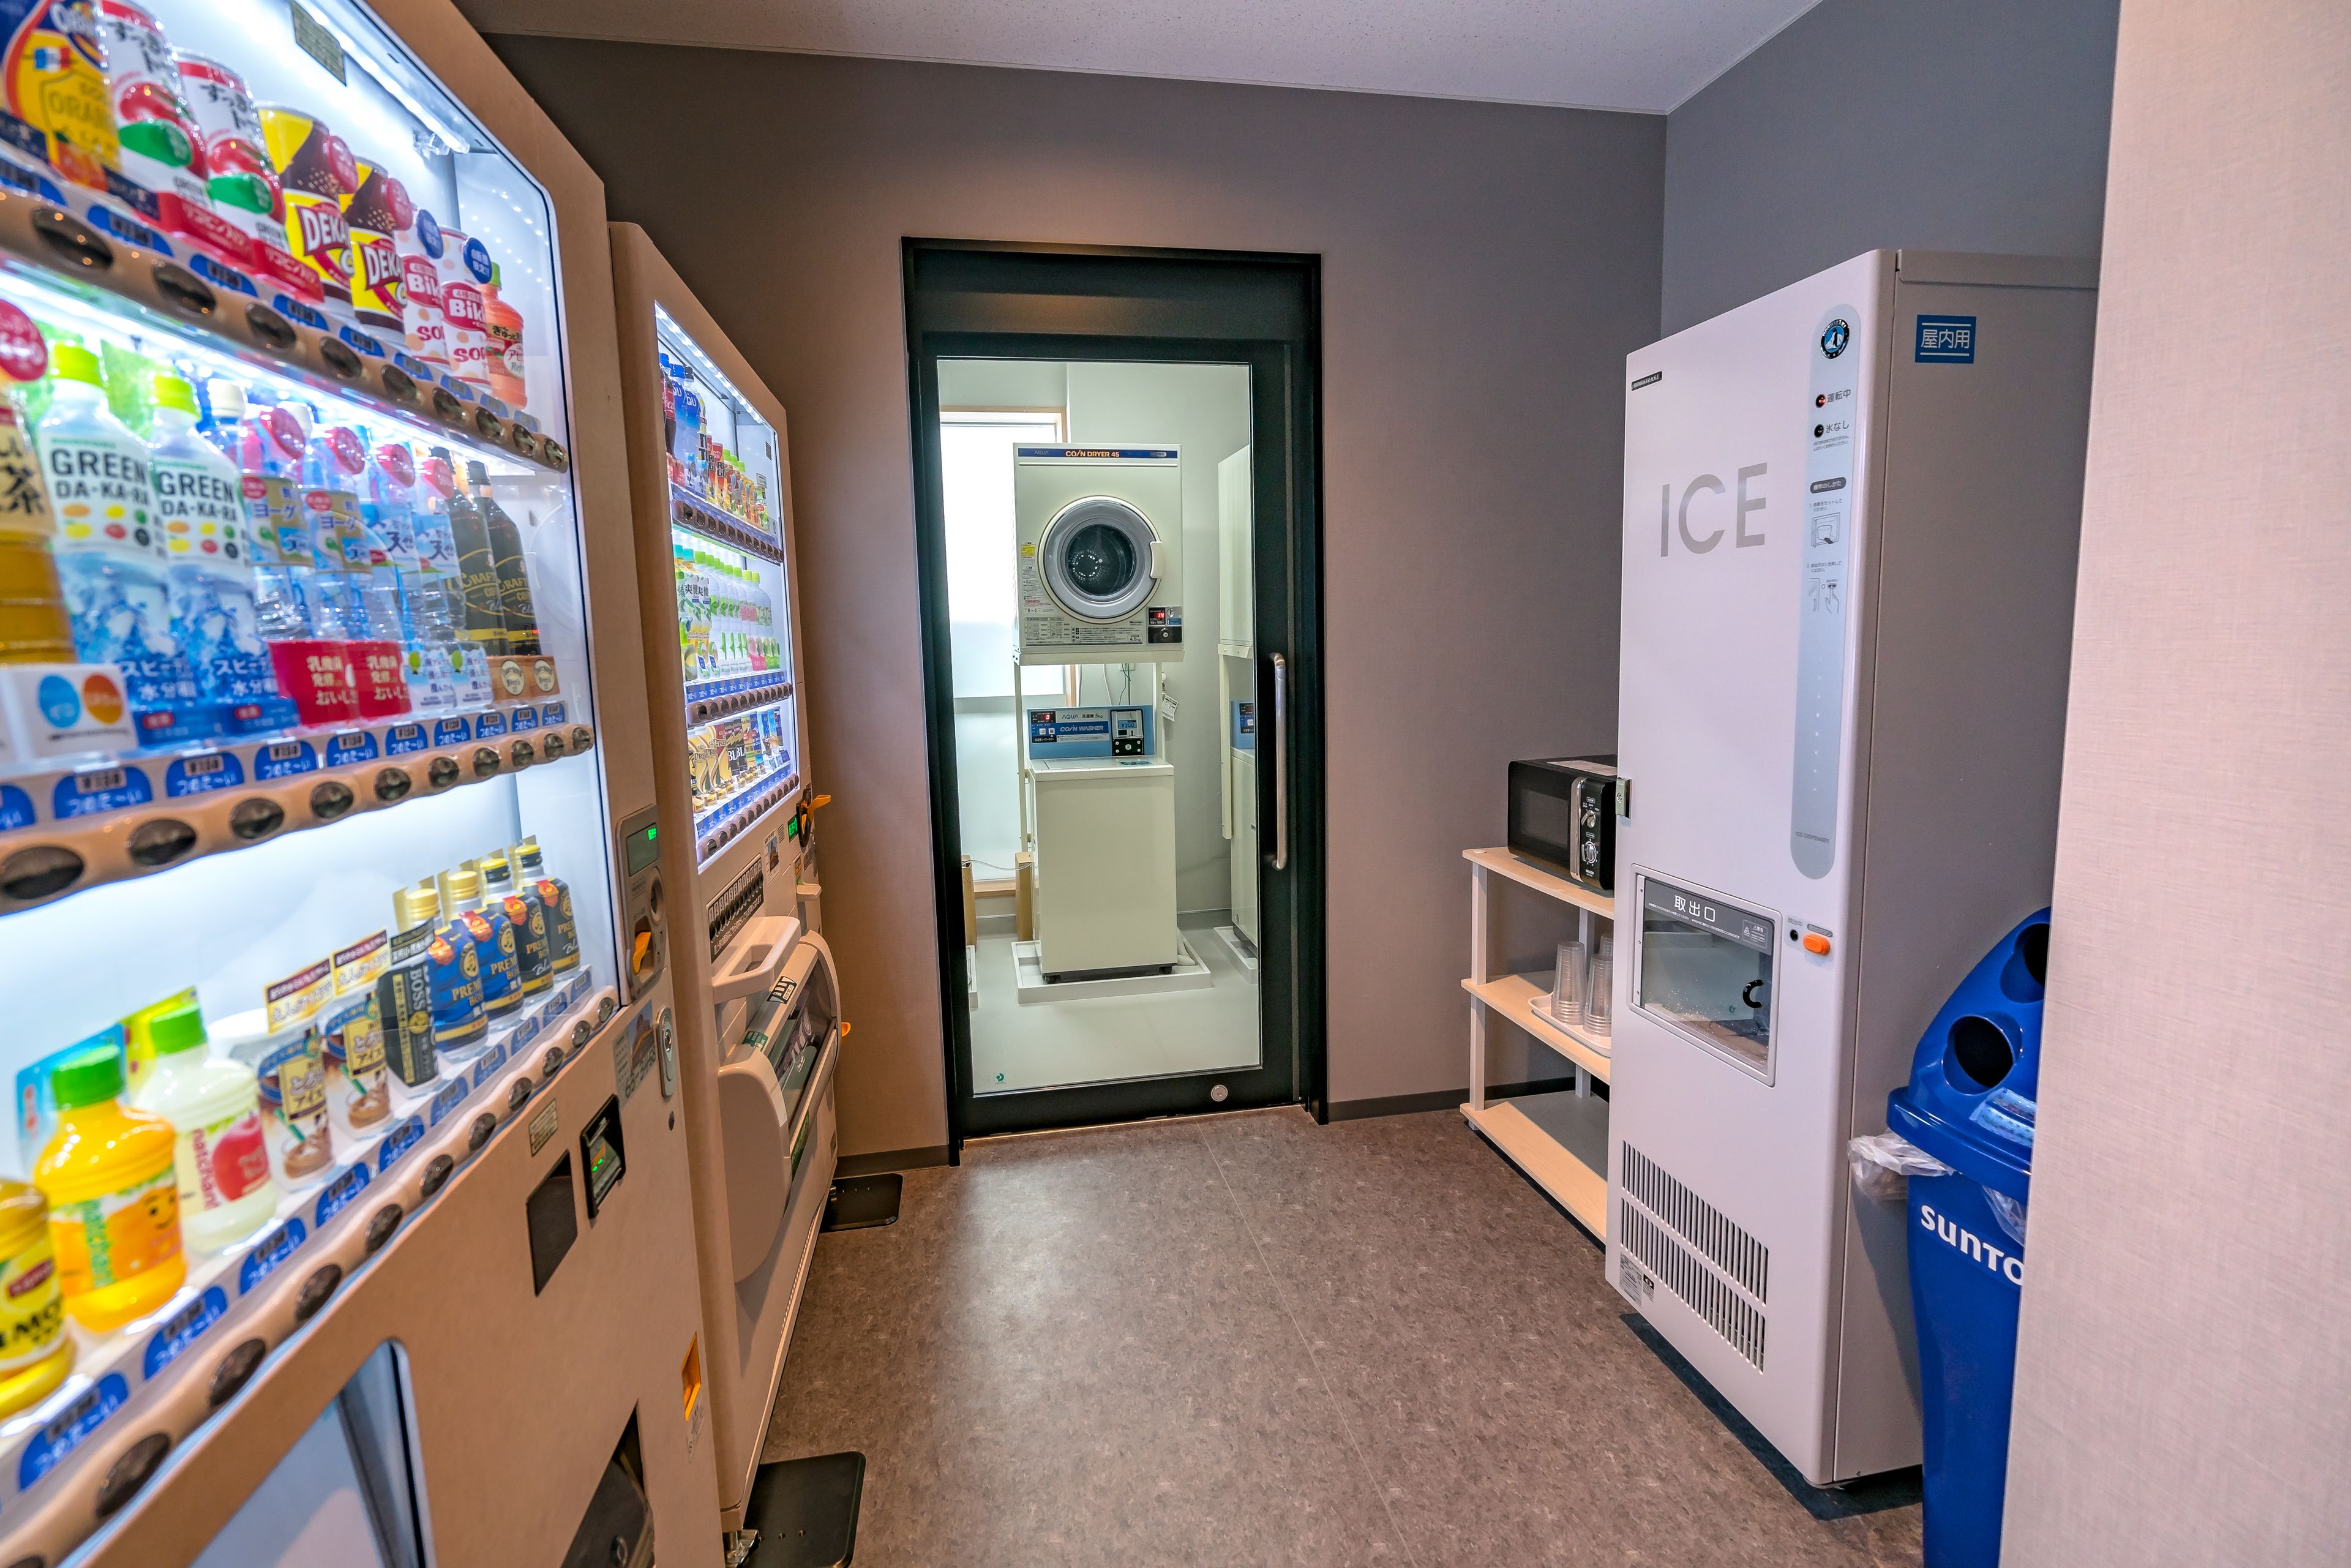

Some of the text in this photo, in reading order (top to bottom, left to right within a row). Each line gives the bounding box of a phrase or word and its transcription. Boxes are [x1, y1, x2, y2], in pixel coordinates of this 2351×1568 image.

[1921, 328, 1970, 349] 屋内用
[1827, 389, 1851, 403] 運転中
[1825, 420, 1850, 433] 氷なし
[51, 448, 148, 486] GREEN
[157, 471, 235, 503] GREEN
[1813, 480, 1842, 490] 操作のしかた
[1660, 462, 1768, 557] ICE
[1674, 895, 1715, 923] 取出口
